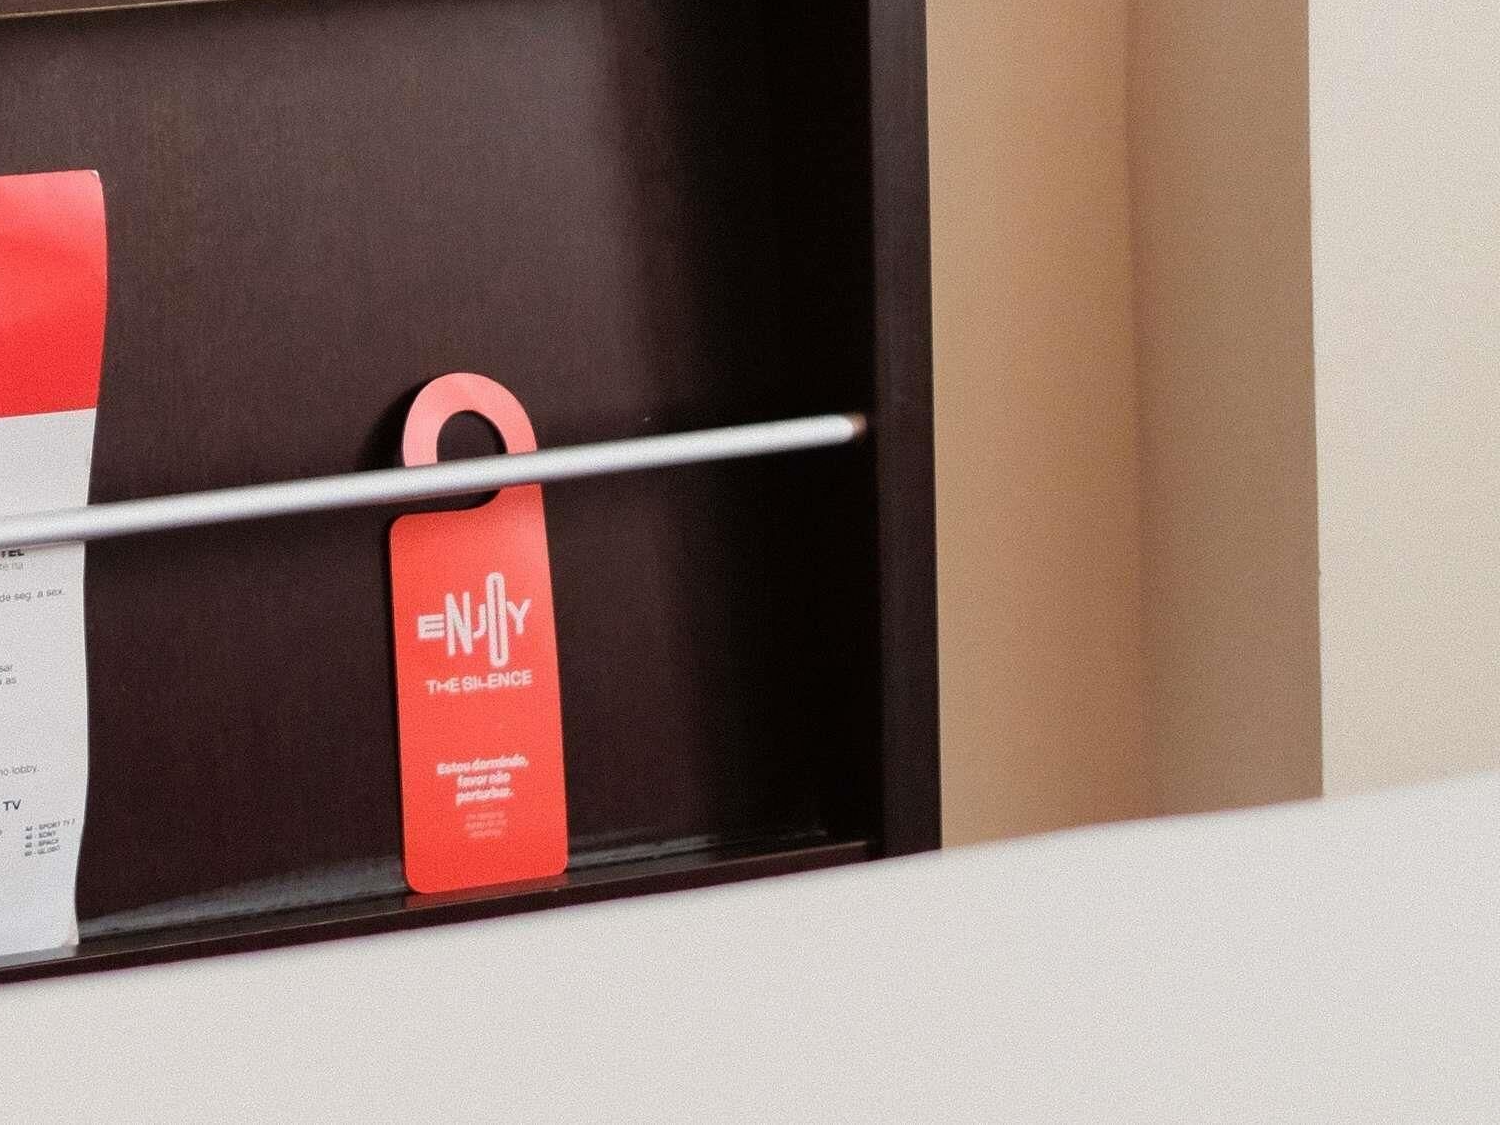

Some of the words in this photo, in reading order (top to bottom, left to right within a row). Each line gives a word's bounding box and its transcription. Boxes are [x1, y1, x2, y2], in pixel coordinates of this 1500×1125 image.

[416, 571, 532, 668] ENJOY
[426, 677, 461, 694] THE
[462, 670, 533, 693] SILENCE
[436, 761, 471, 775] Estou
[2, 798, 22, 812] TV
